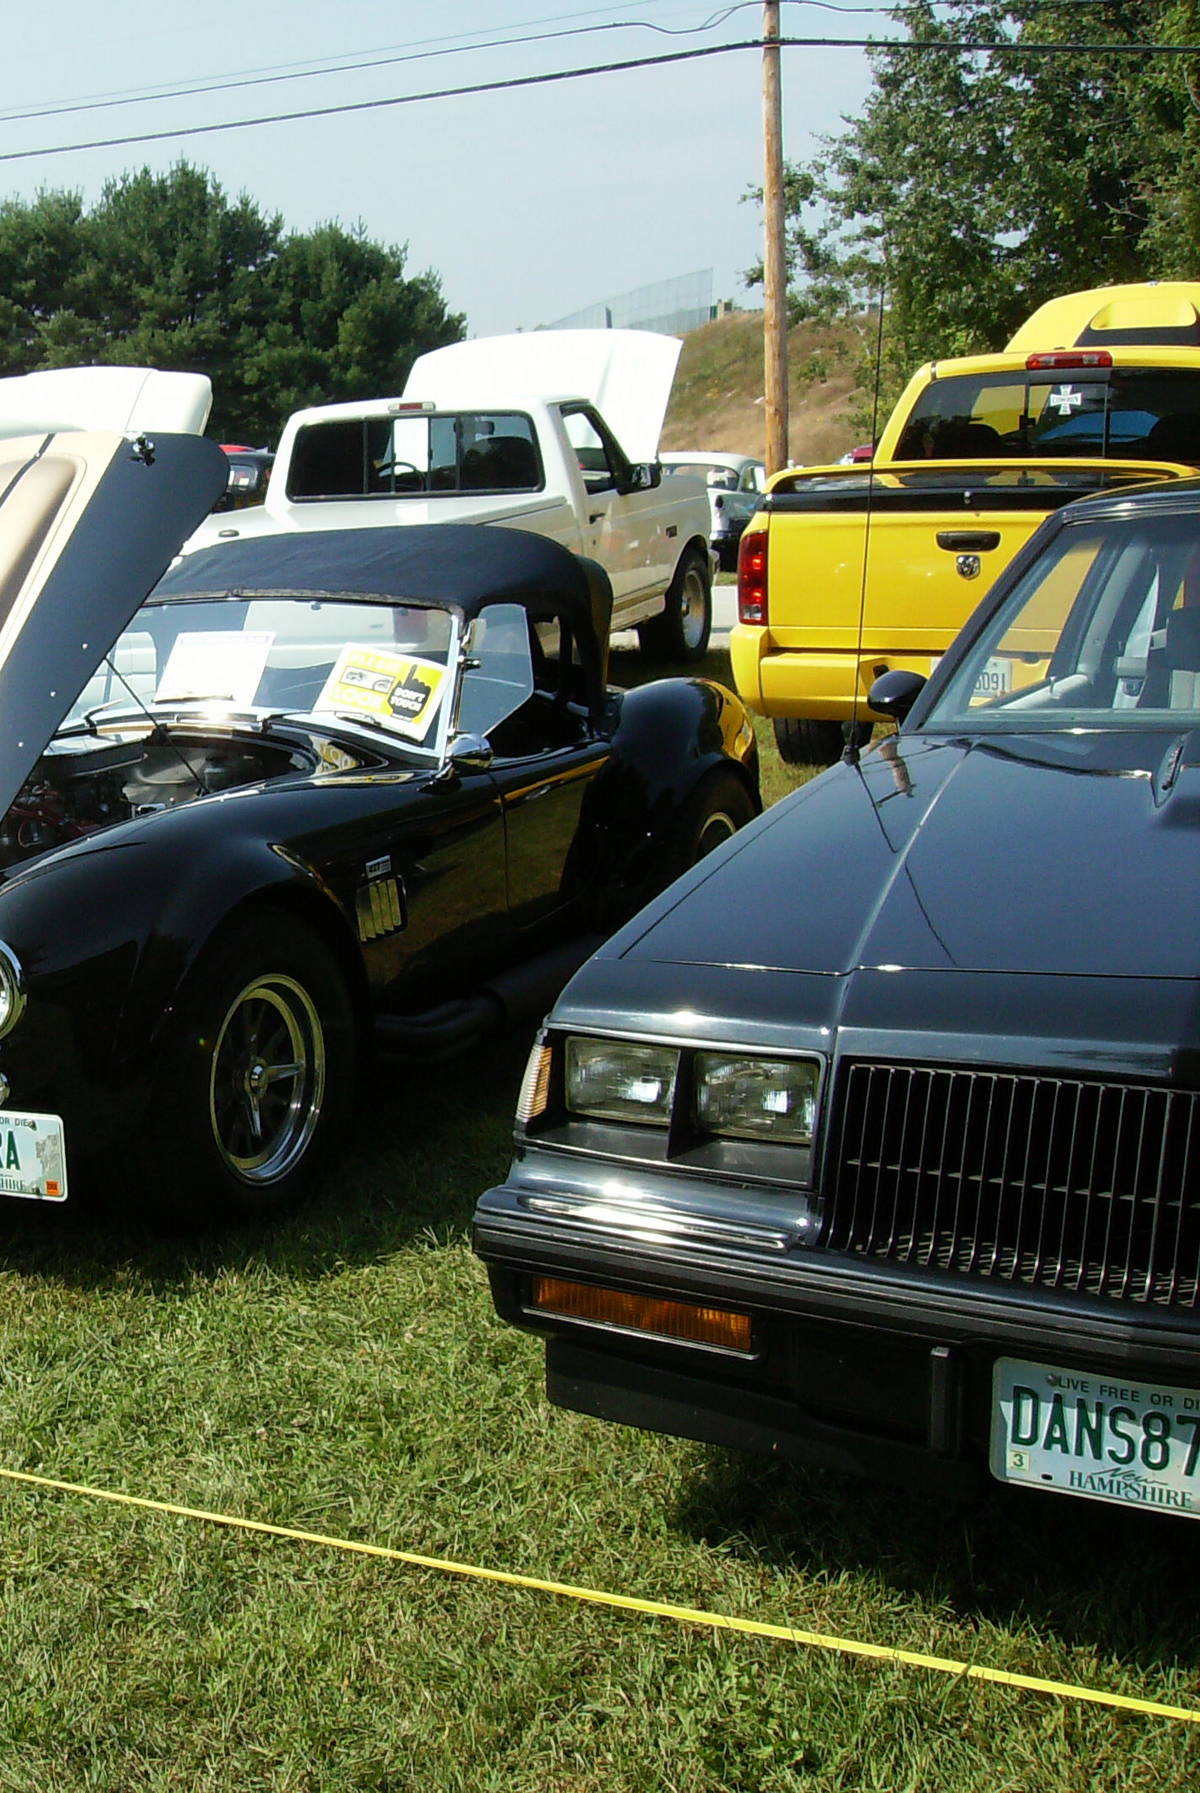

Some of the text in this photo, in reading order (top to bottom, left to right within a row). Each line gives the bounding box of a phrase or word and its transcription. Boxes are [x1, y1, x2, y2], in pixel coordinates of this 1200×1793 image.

[390, 695, 423, 712] TOUCH
[0, 1116, 10, 1125] OR
[14, 1118, 29, 1127] DIE
[1058, 1377, 1200, 1411] LIVE FREE OR DI
[1010, 1385, 1200, 1477] DANS87
[1013, 1453, 1024, 1467] 3
[1069, 1470, 1193, 1508] HAMPSHIRE
